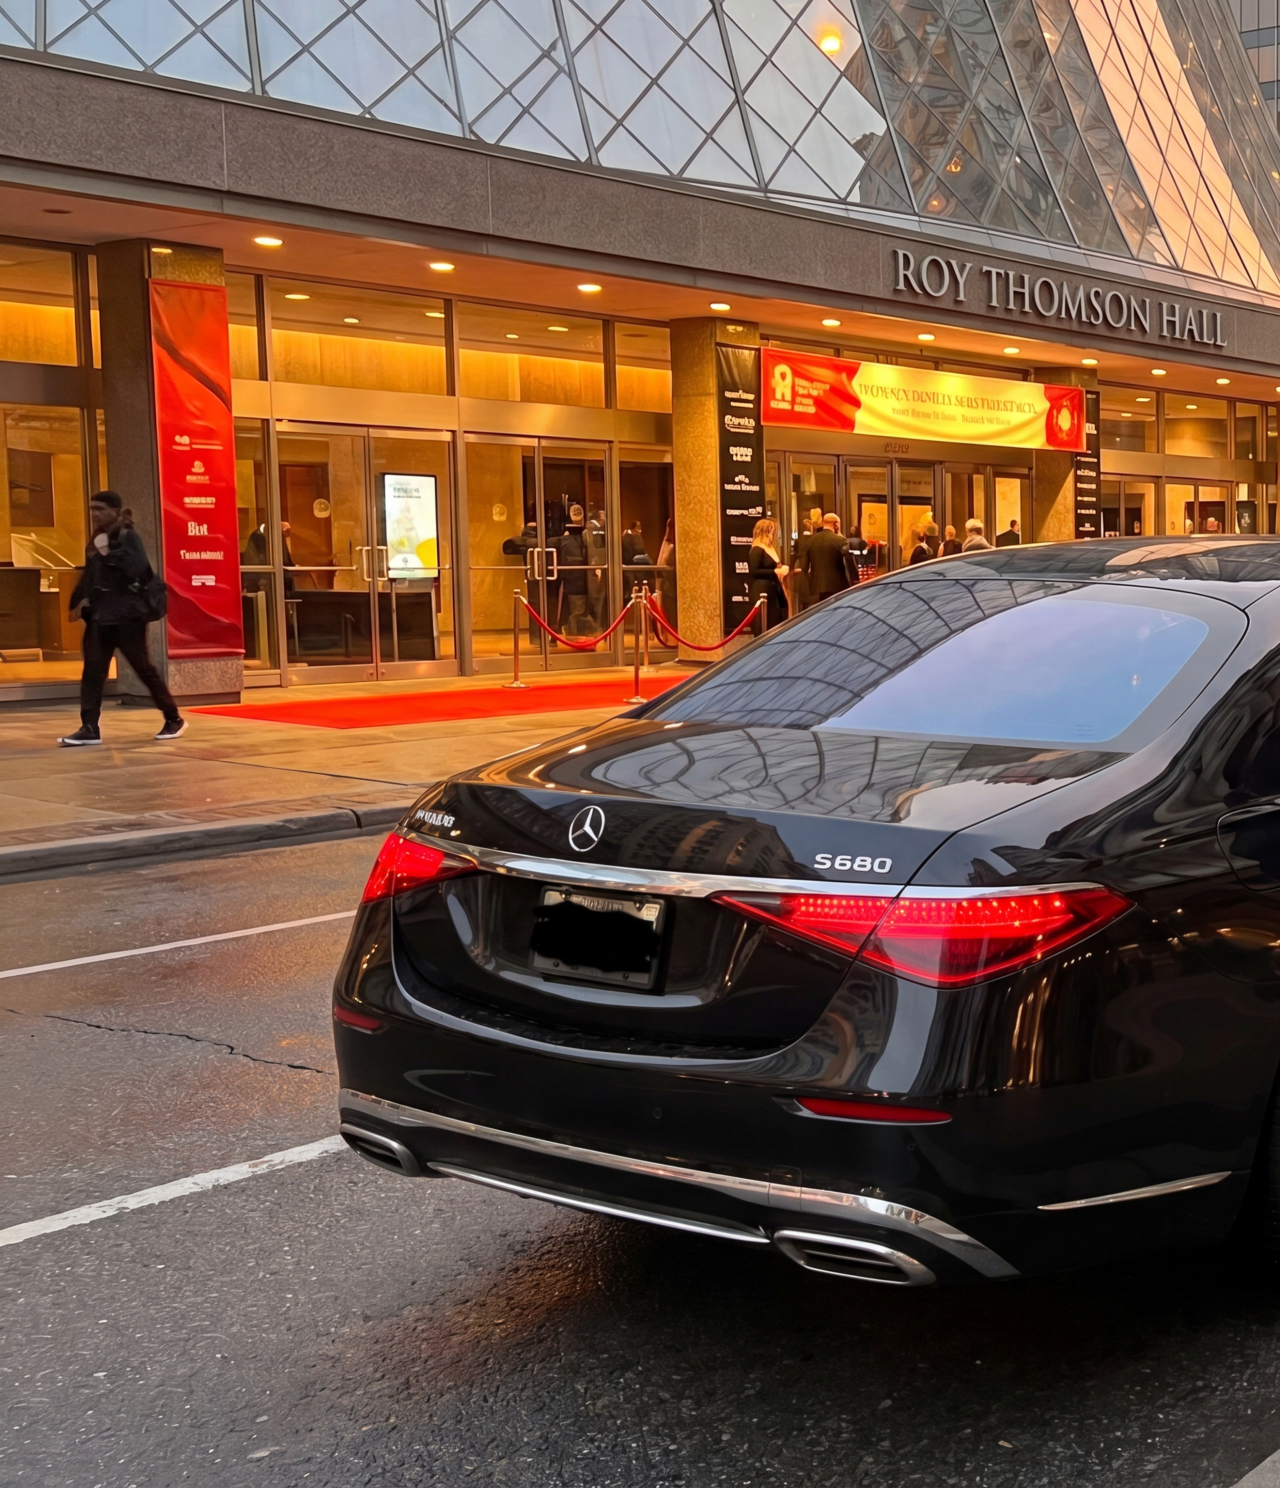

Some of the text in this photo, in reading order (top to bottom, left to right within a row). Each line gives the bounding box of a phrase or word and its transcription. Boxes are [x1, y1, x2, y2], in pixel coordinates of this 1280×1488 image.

[893, 249, 1228, 347] ROY THOMSON HALL
[813, 853, 893, 874] S680
